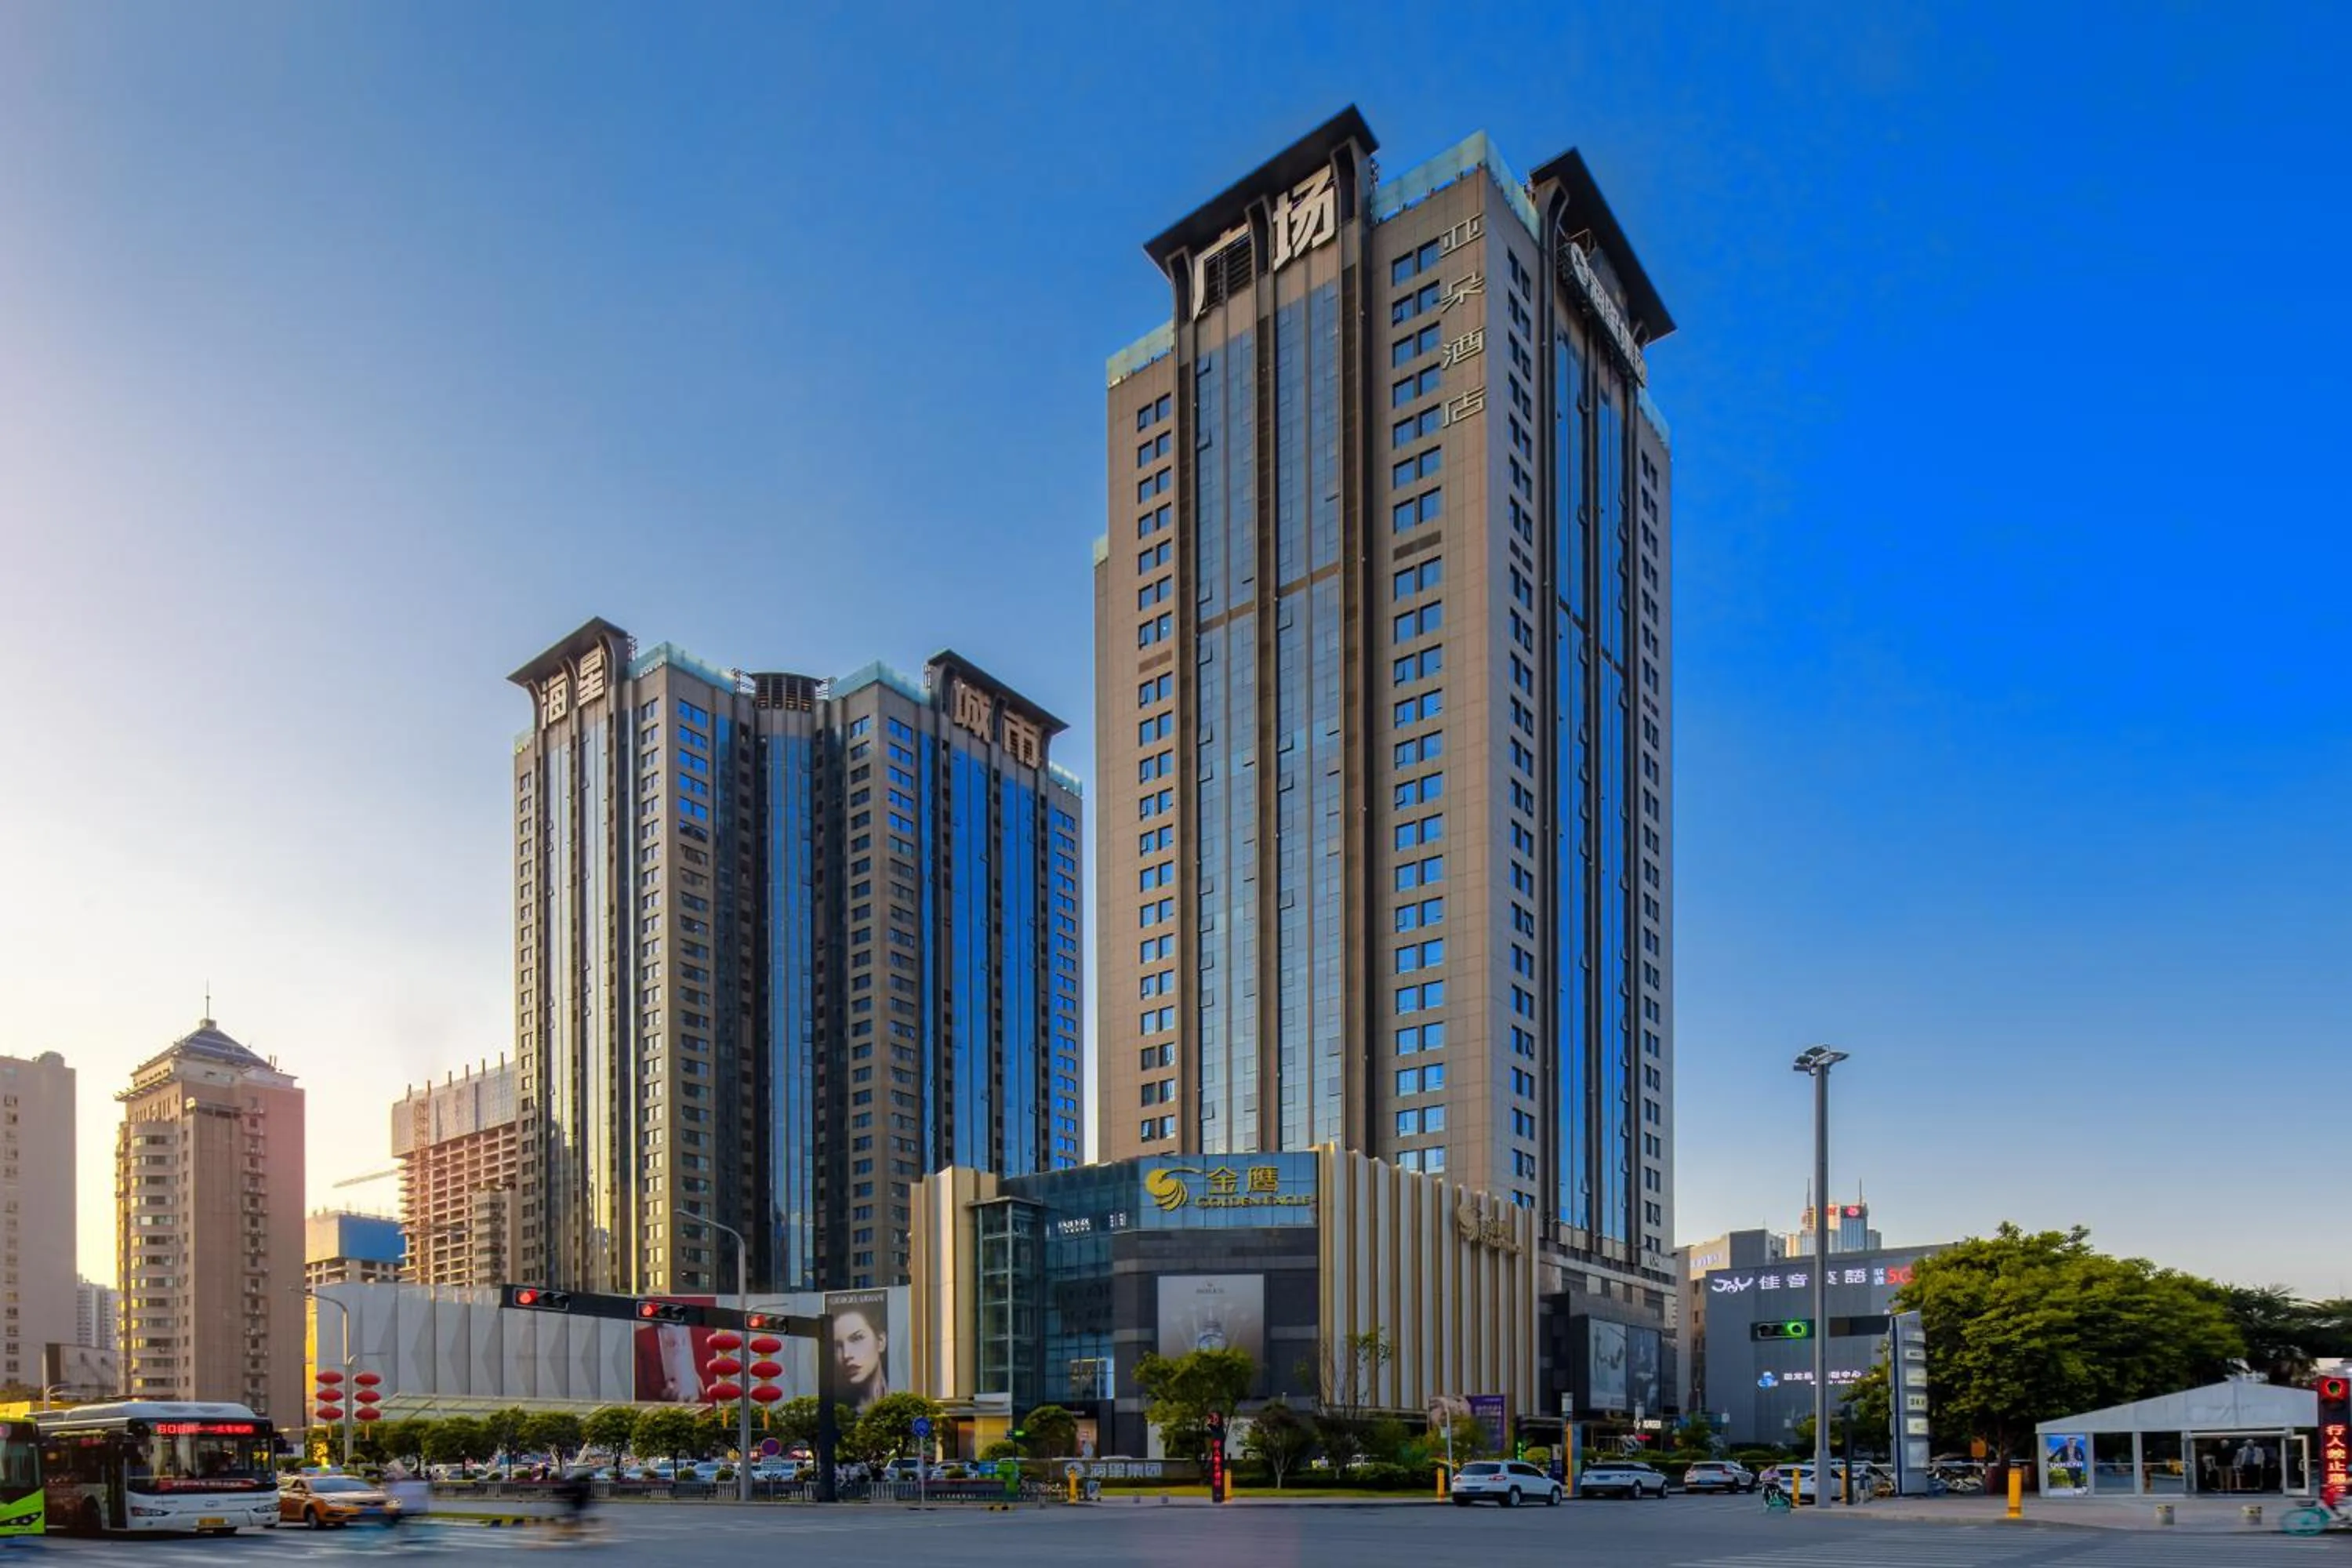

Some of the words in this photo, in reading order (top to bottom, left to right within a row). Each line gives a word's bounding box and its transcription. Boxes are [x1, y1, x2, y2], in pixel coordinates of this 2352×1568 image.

[1192, 163, 1335, 322] 广场
[1440, 213, 1486, 428] 亚朵酒店
[1207, 1166, 1279, 1195] 金鹰
